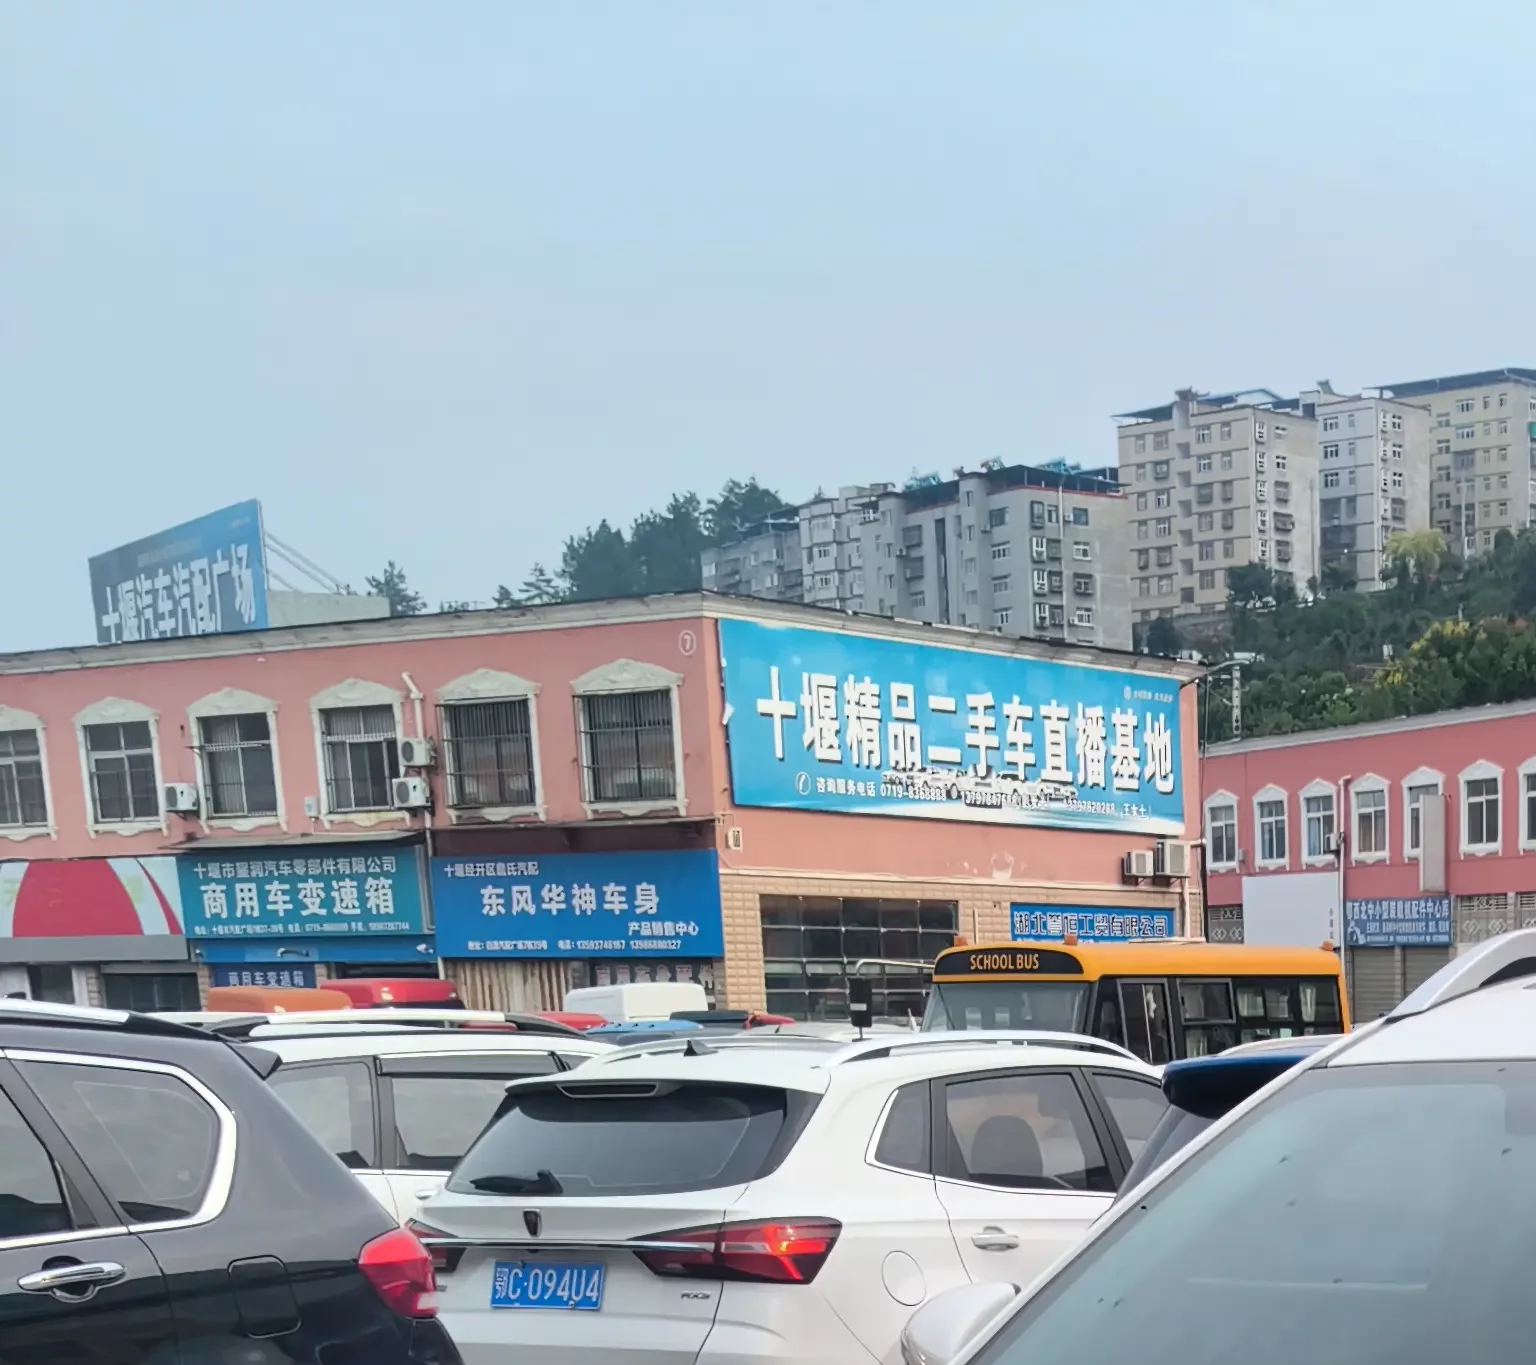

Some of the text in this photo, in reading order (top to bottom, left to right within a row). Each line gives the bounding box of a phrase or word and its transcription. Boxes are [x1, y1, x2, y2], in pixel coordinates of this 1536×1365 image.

[756, 666, 1175, 794] 十堰精品二手车直播基地
[815, 776, 877, 797] 咨询服务电话
[200, 876, 395, 919] 商用车变速箱
[480, 882, 660, 916] 东风华神车身
[628, 921, 700, 937] 产品销售中心
[970, 953, 1040, 970] SCHOOL BUS
[228, 971, 305, 987] 商用车变速箱
